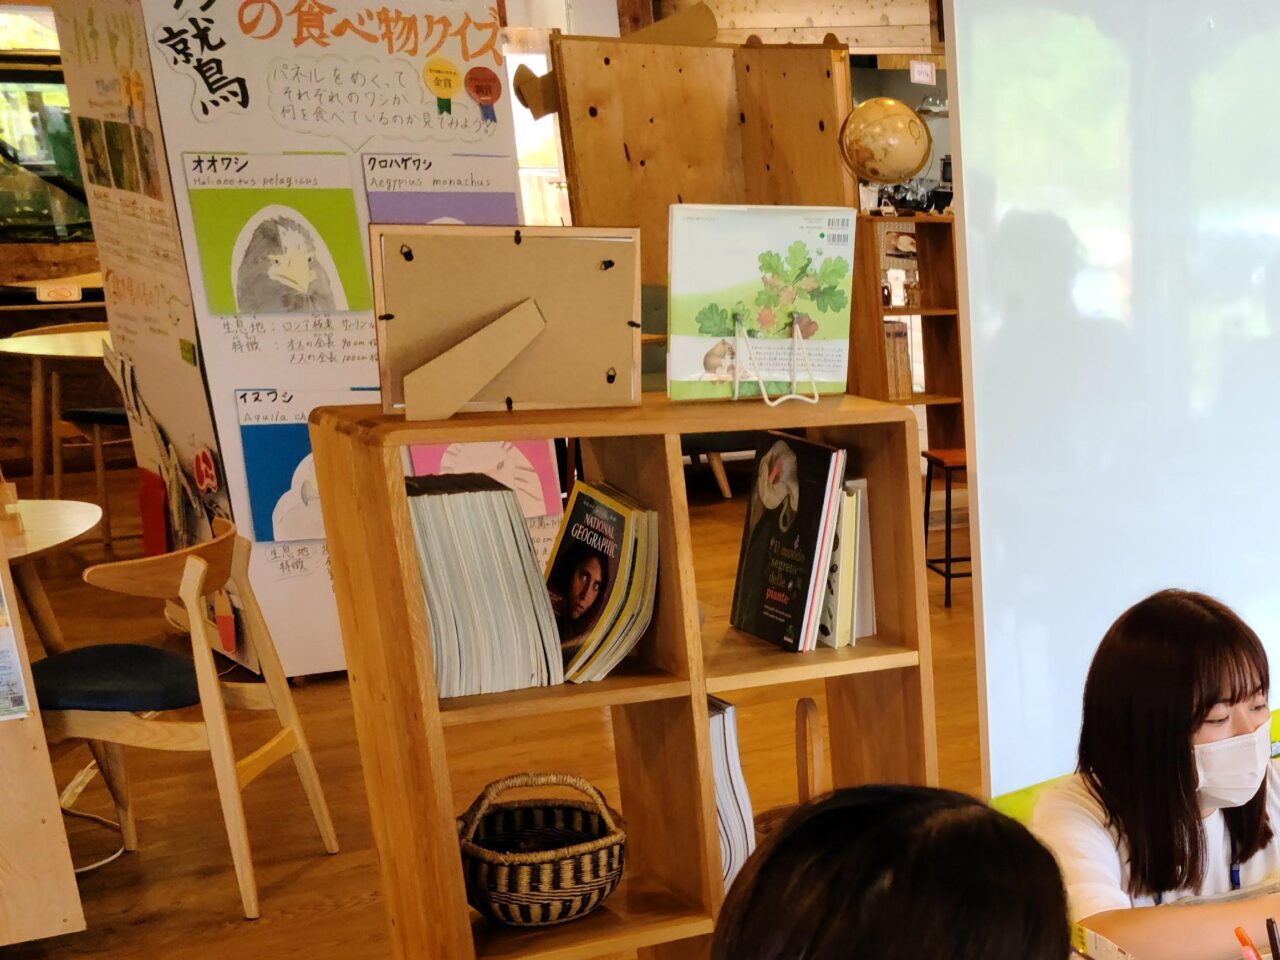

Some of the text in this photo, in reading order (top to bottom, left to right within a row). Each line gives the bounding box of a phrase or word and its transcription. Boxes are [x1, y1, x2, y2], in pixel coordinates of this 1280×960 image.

[238, 0, 504, 66] の食べ物クイズ
[192, 155, 249, 173] オオワシ
[571, 522, 618, 559] GEOGRAPHIC
[584, 512, 615, 540] NATIONAL
